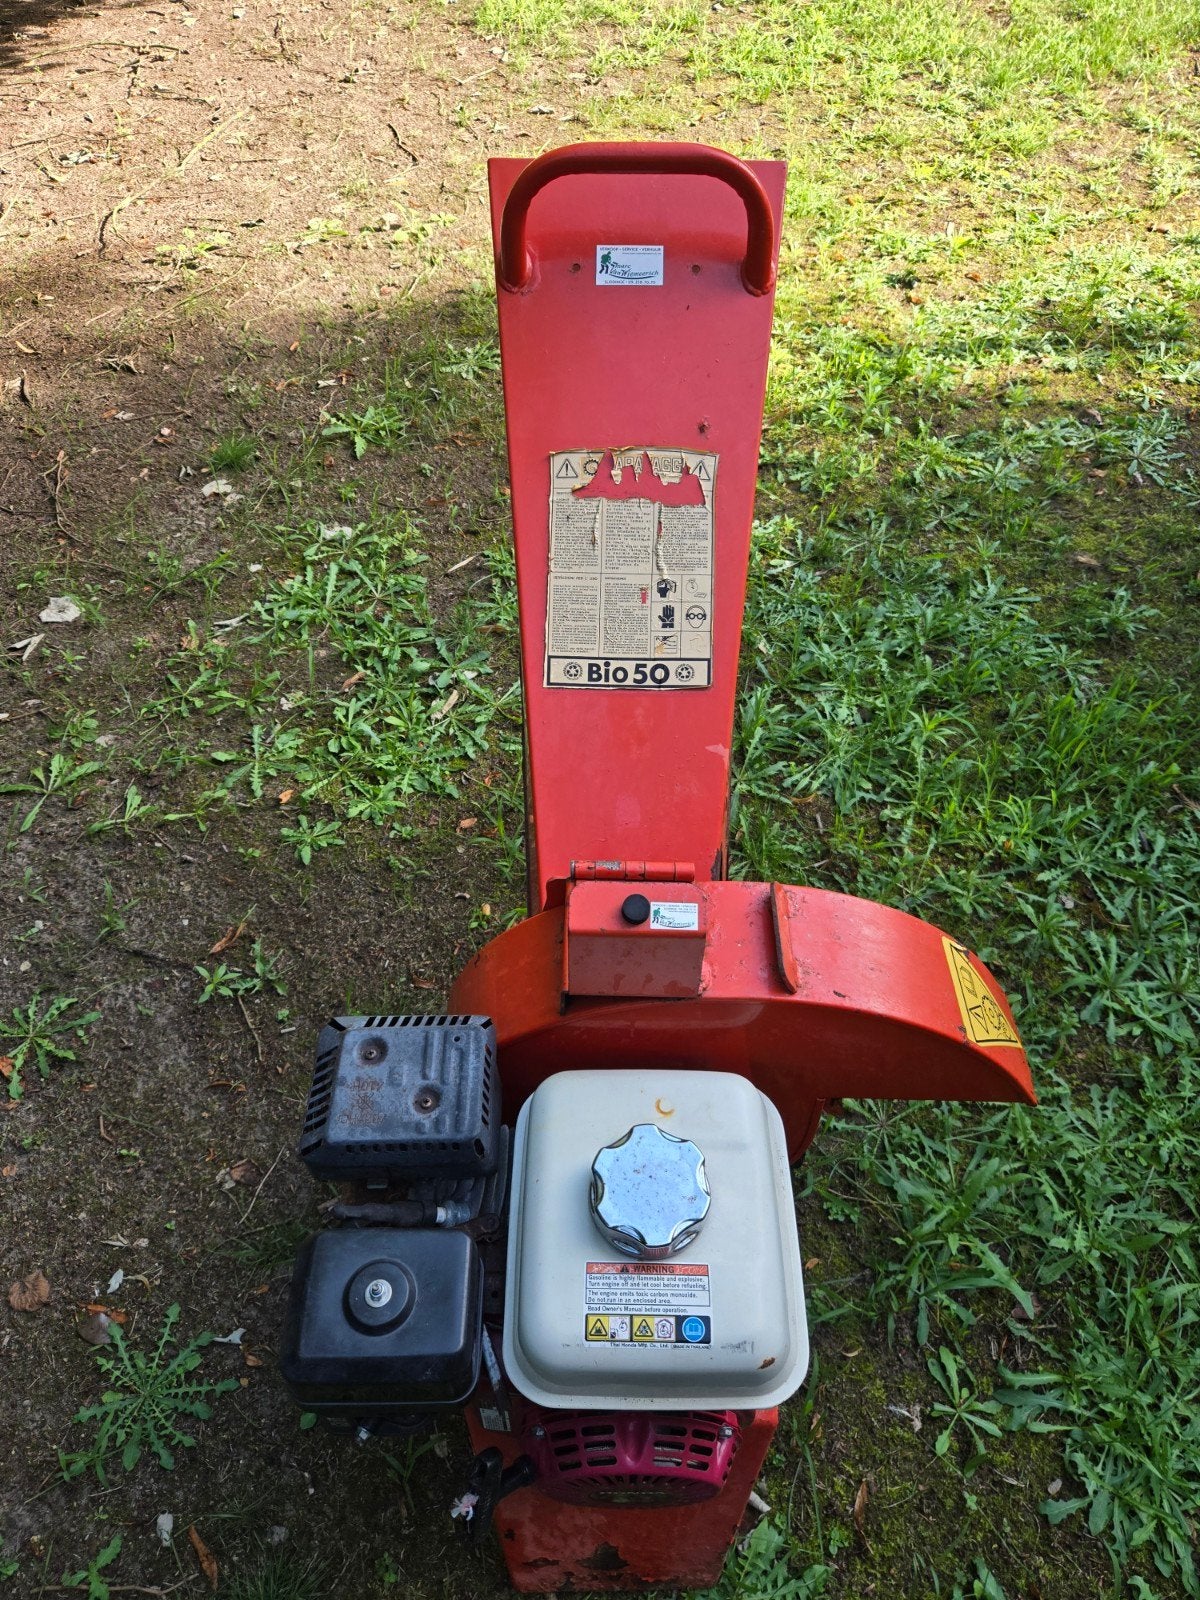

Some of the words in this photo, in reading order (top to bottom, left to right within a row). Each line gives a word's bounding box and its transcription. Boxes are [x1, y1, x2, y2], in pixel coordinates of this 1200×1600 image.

[588, 661, 629, 683] Bio
[633, 663, 670, 684] 50
[633, 1265, 675, 1273] WARNING
